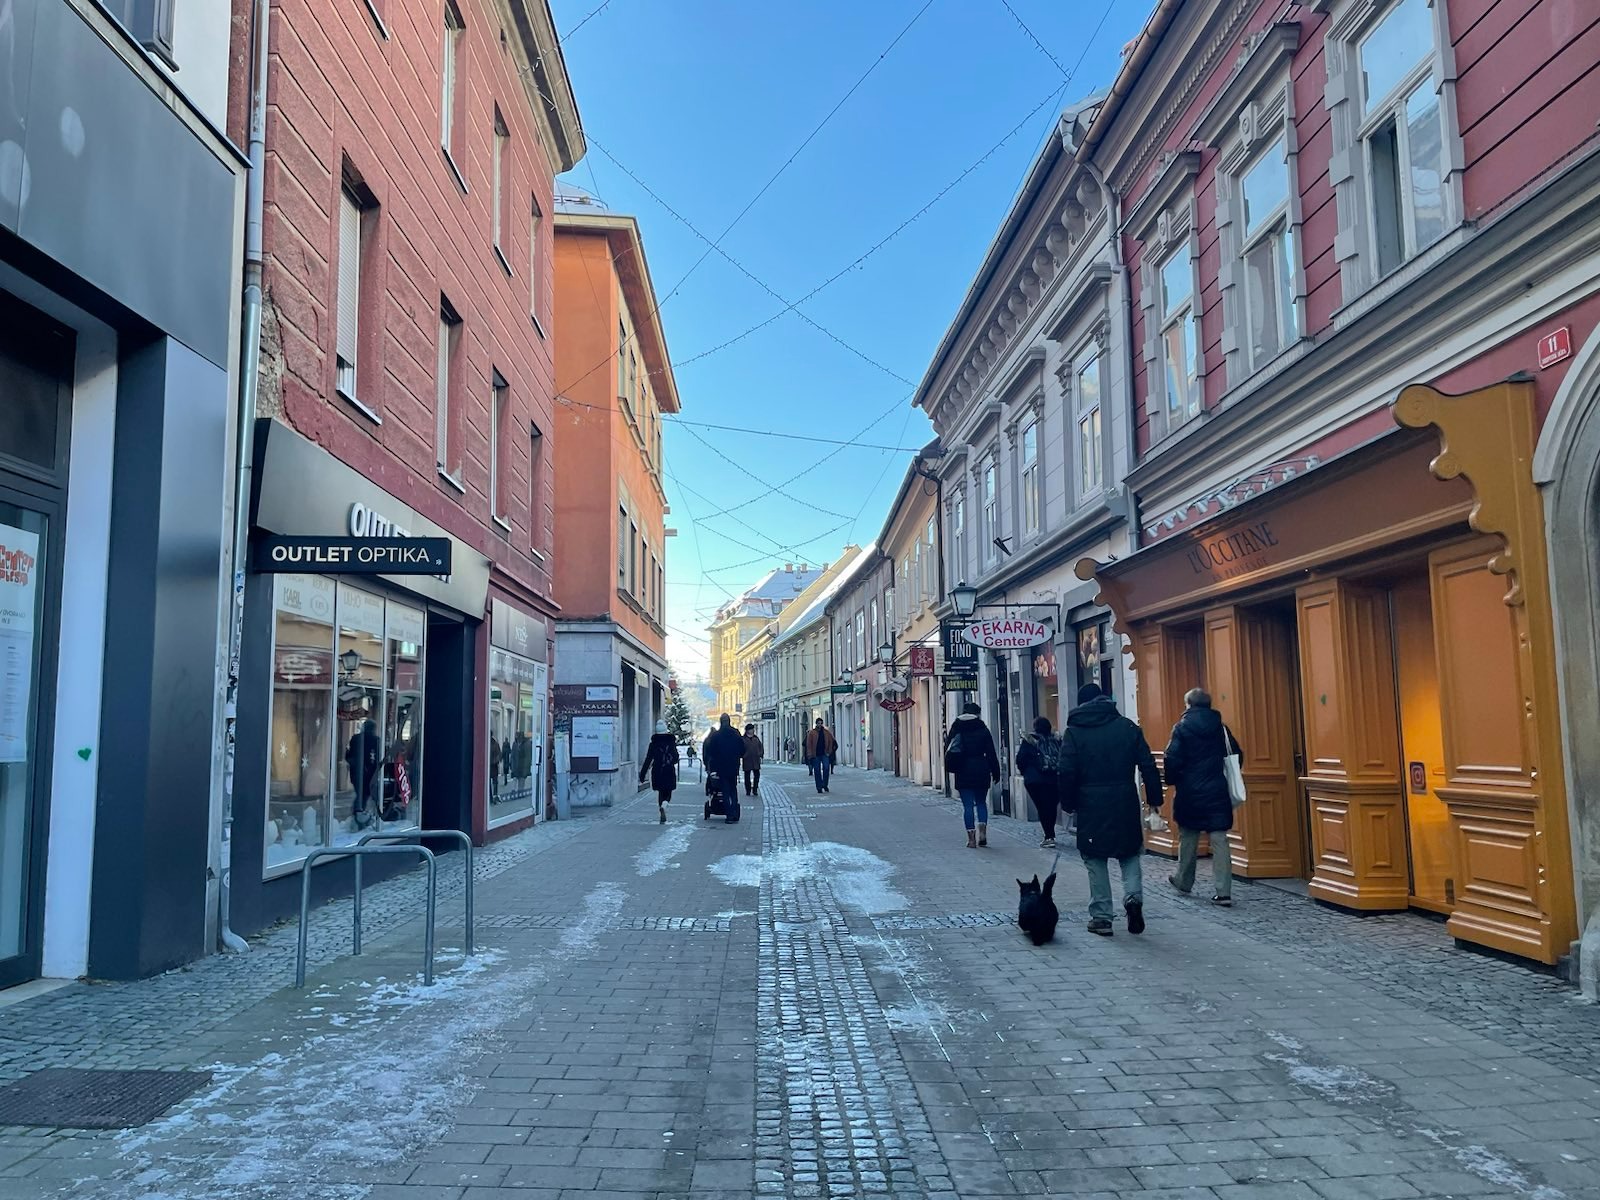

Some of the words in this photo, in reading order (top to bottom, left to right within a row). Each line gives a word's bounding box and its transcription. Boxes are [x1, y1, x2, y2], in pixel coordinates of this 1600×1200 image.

[1548, 336, 1558, 353] 11
[350, 502, 412, 538] OUTL
[272, 545, 353, 563] OUTLET
[357, 547, 430, 563] OPTIKA
[950, 629, 965, 644] FOT
[971, 621, 1046, 639] PEKARNA
[984, 636, 1032, 647] Center
[950, 643, 972, 658] FINO
[945, 680, 977, 690] DOKUMENTE
